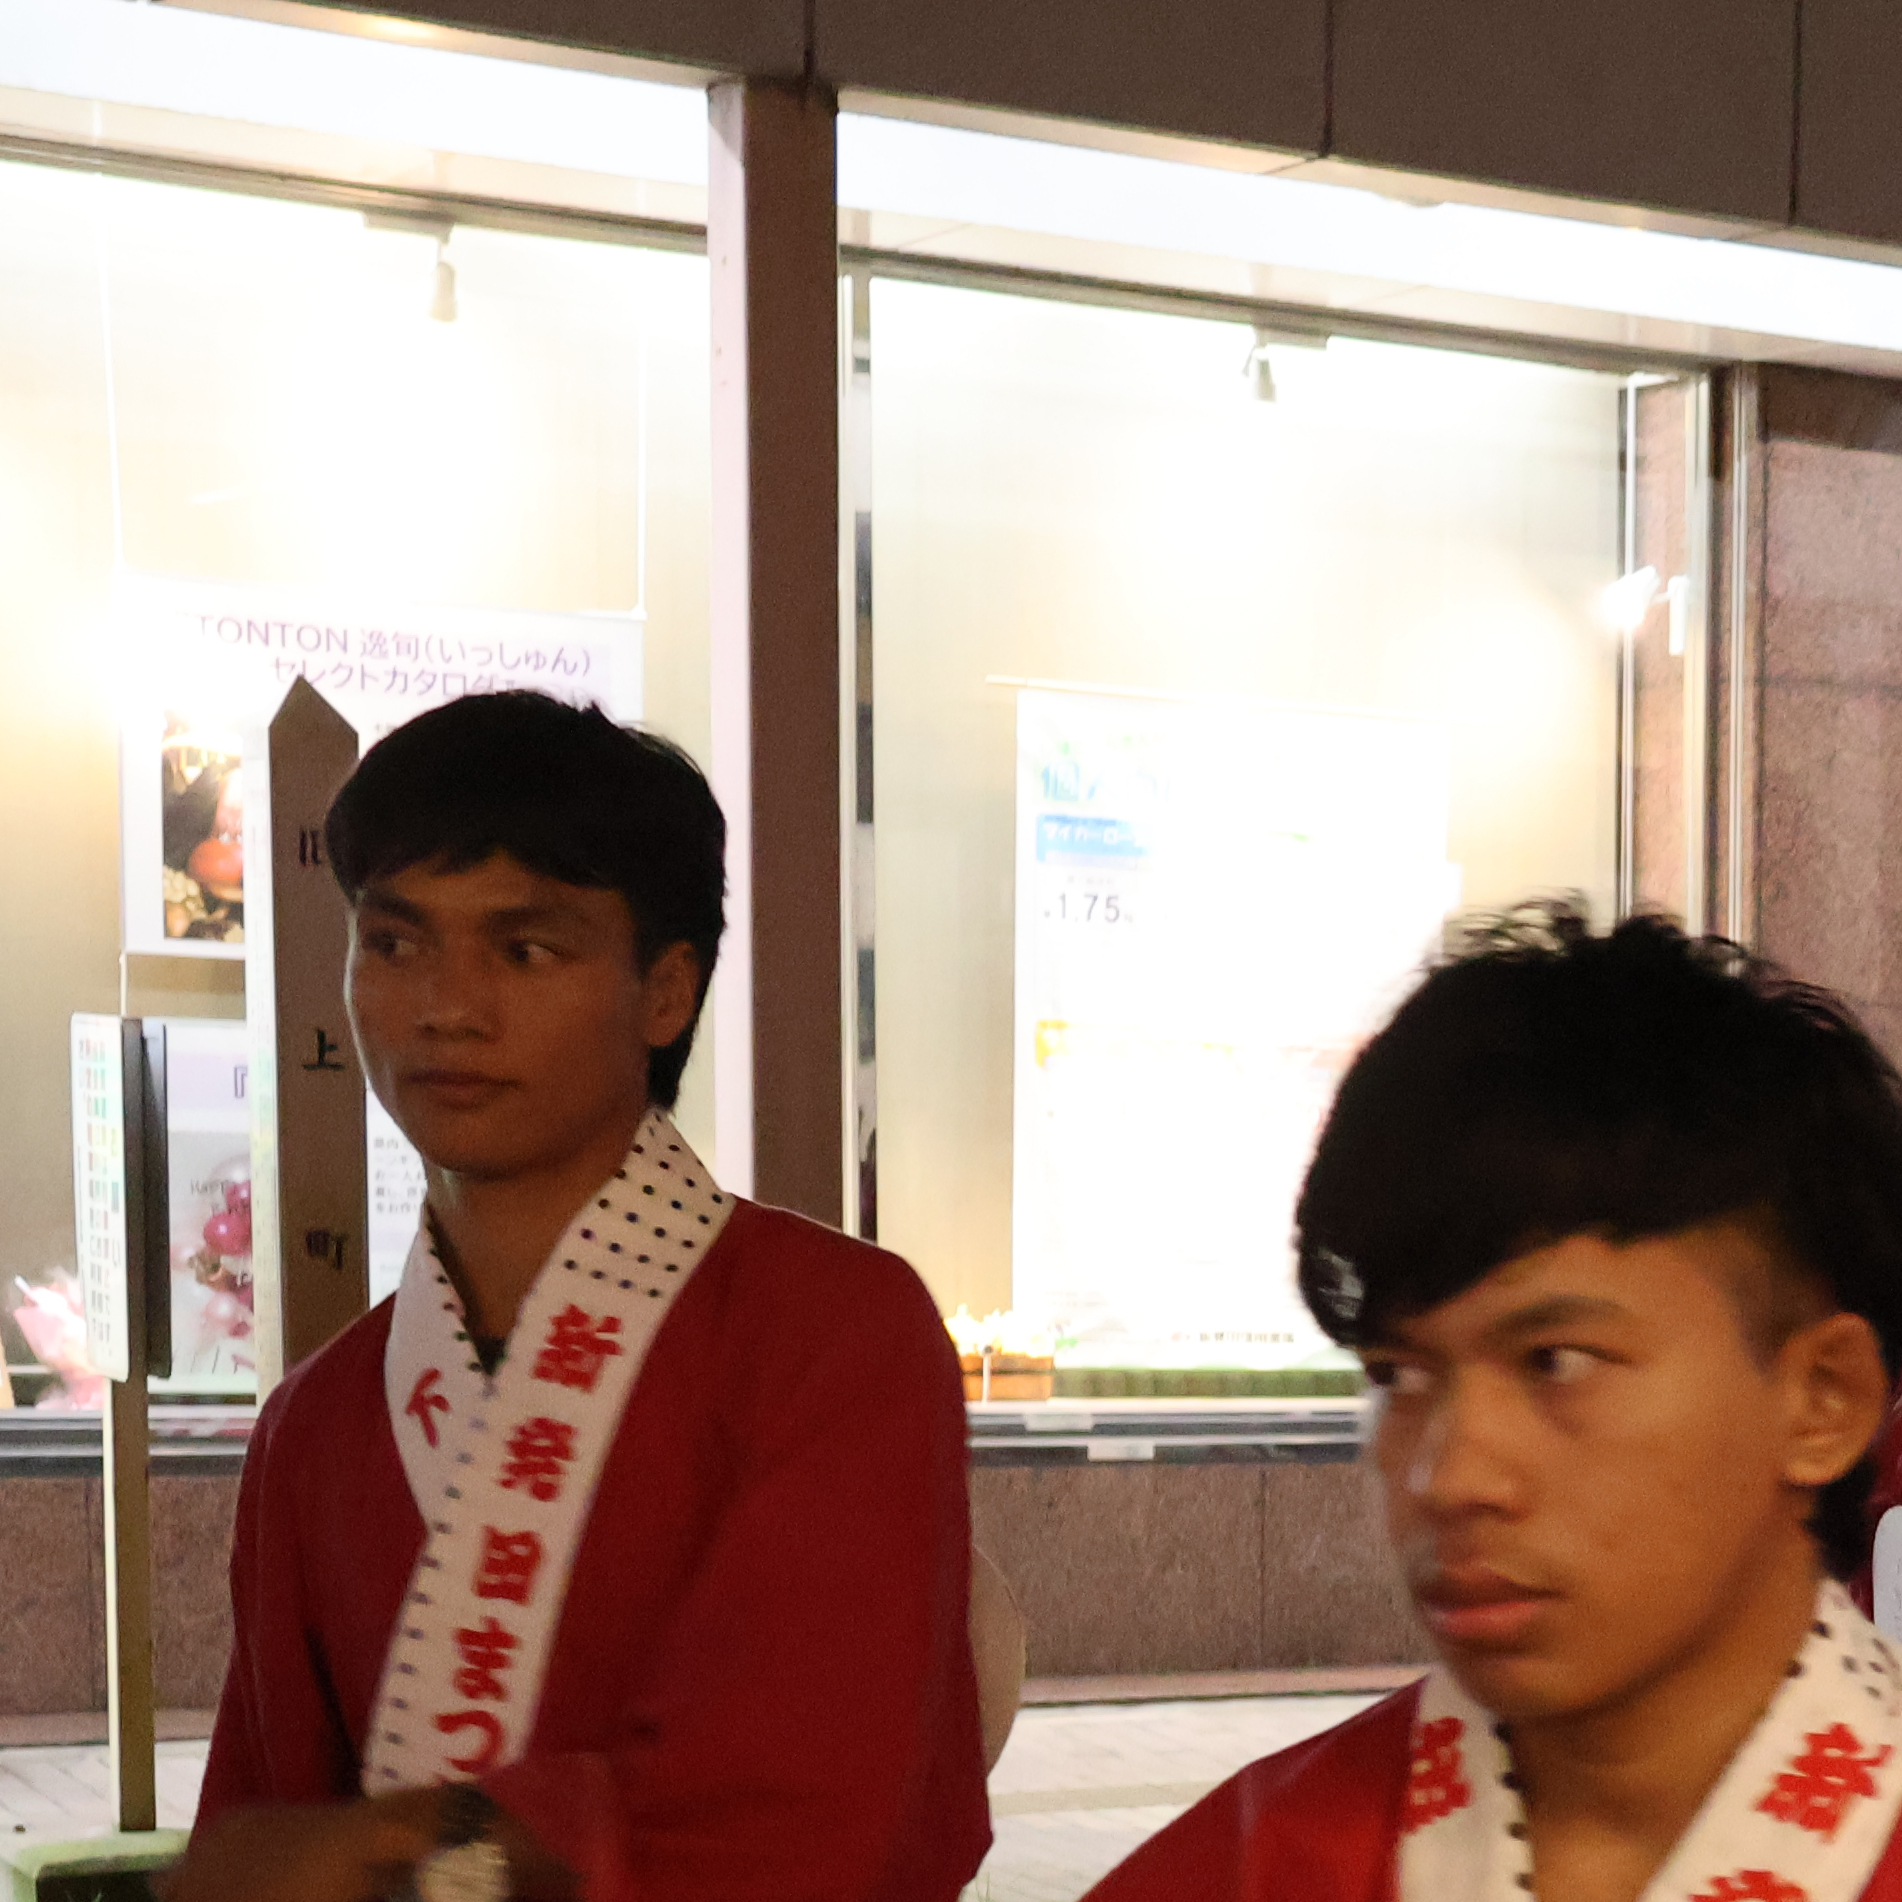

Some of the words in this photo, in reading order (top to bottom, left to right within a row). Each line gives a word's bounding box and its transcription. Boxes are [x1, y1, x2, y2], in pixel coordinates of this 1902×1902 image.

[200, 613, 349, 655] TONTON
[272, 655, 516, 697] セレクトカタログ
[432, 1303, 624, 1782] 新発田まつ
